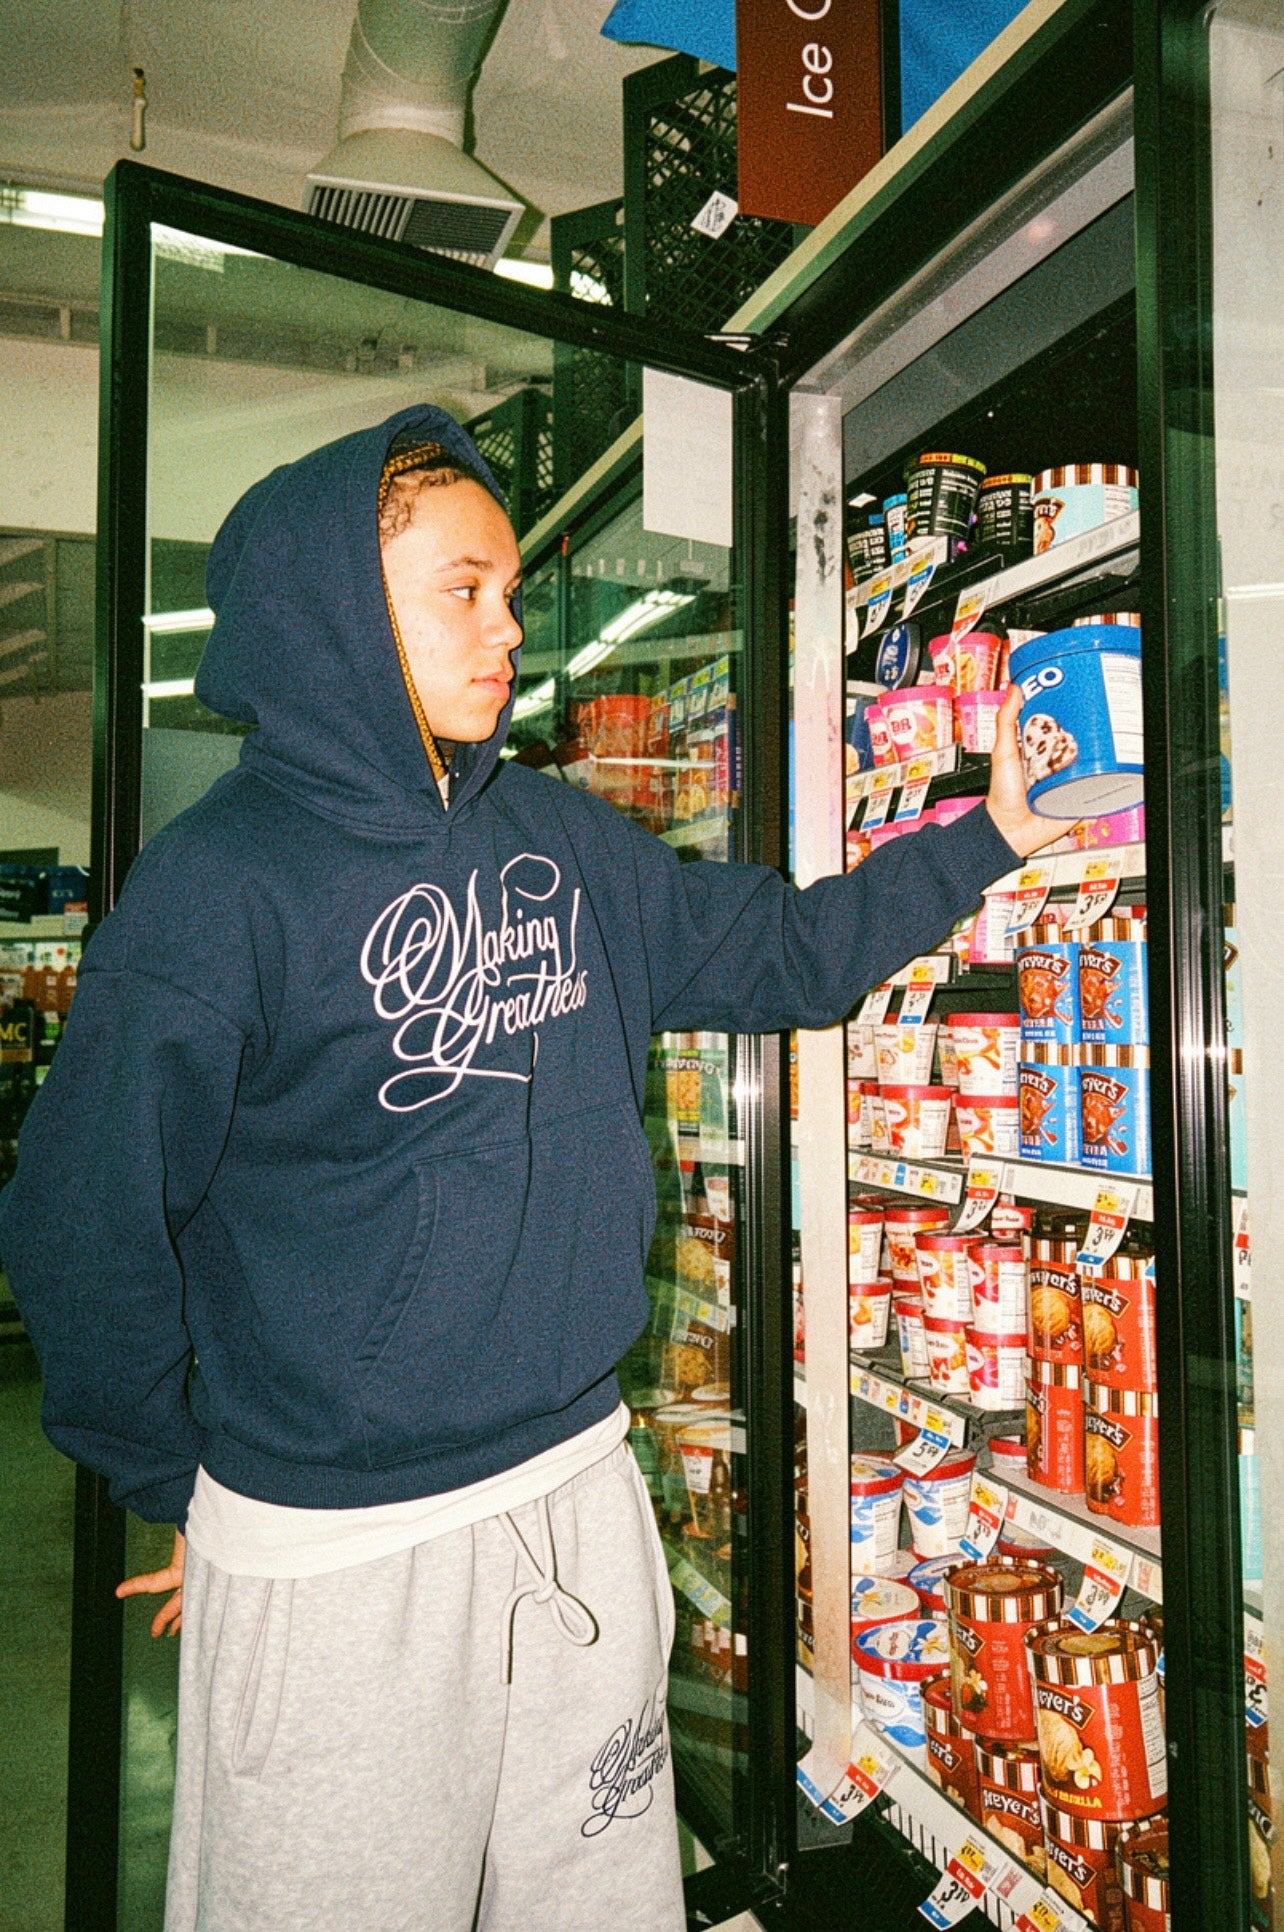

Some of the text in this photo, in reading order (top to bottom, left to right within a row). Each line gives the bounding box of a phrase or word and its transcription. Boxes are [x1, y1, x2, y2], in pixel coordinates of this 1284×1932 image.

[786, 43, 834, 119] Ice
[1021, 666, 1064, 701] EO
[360, 853, 581, 1020] Making
[378, 960, 588, 1112] Greatness
